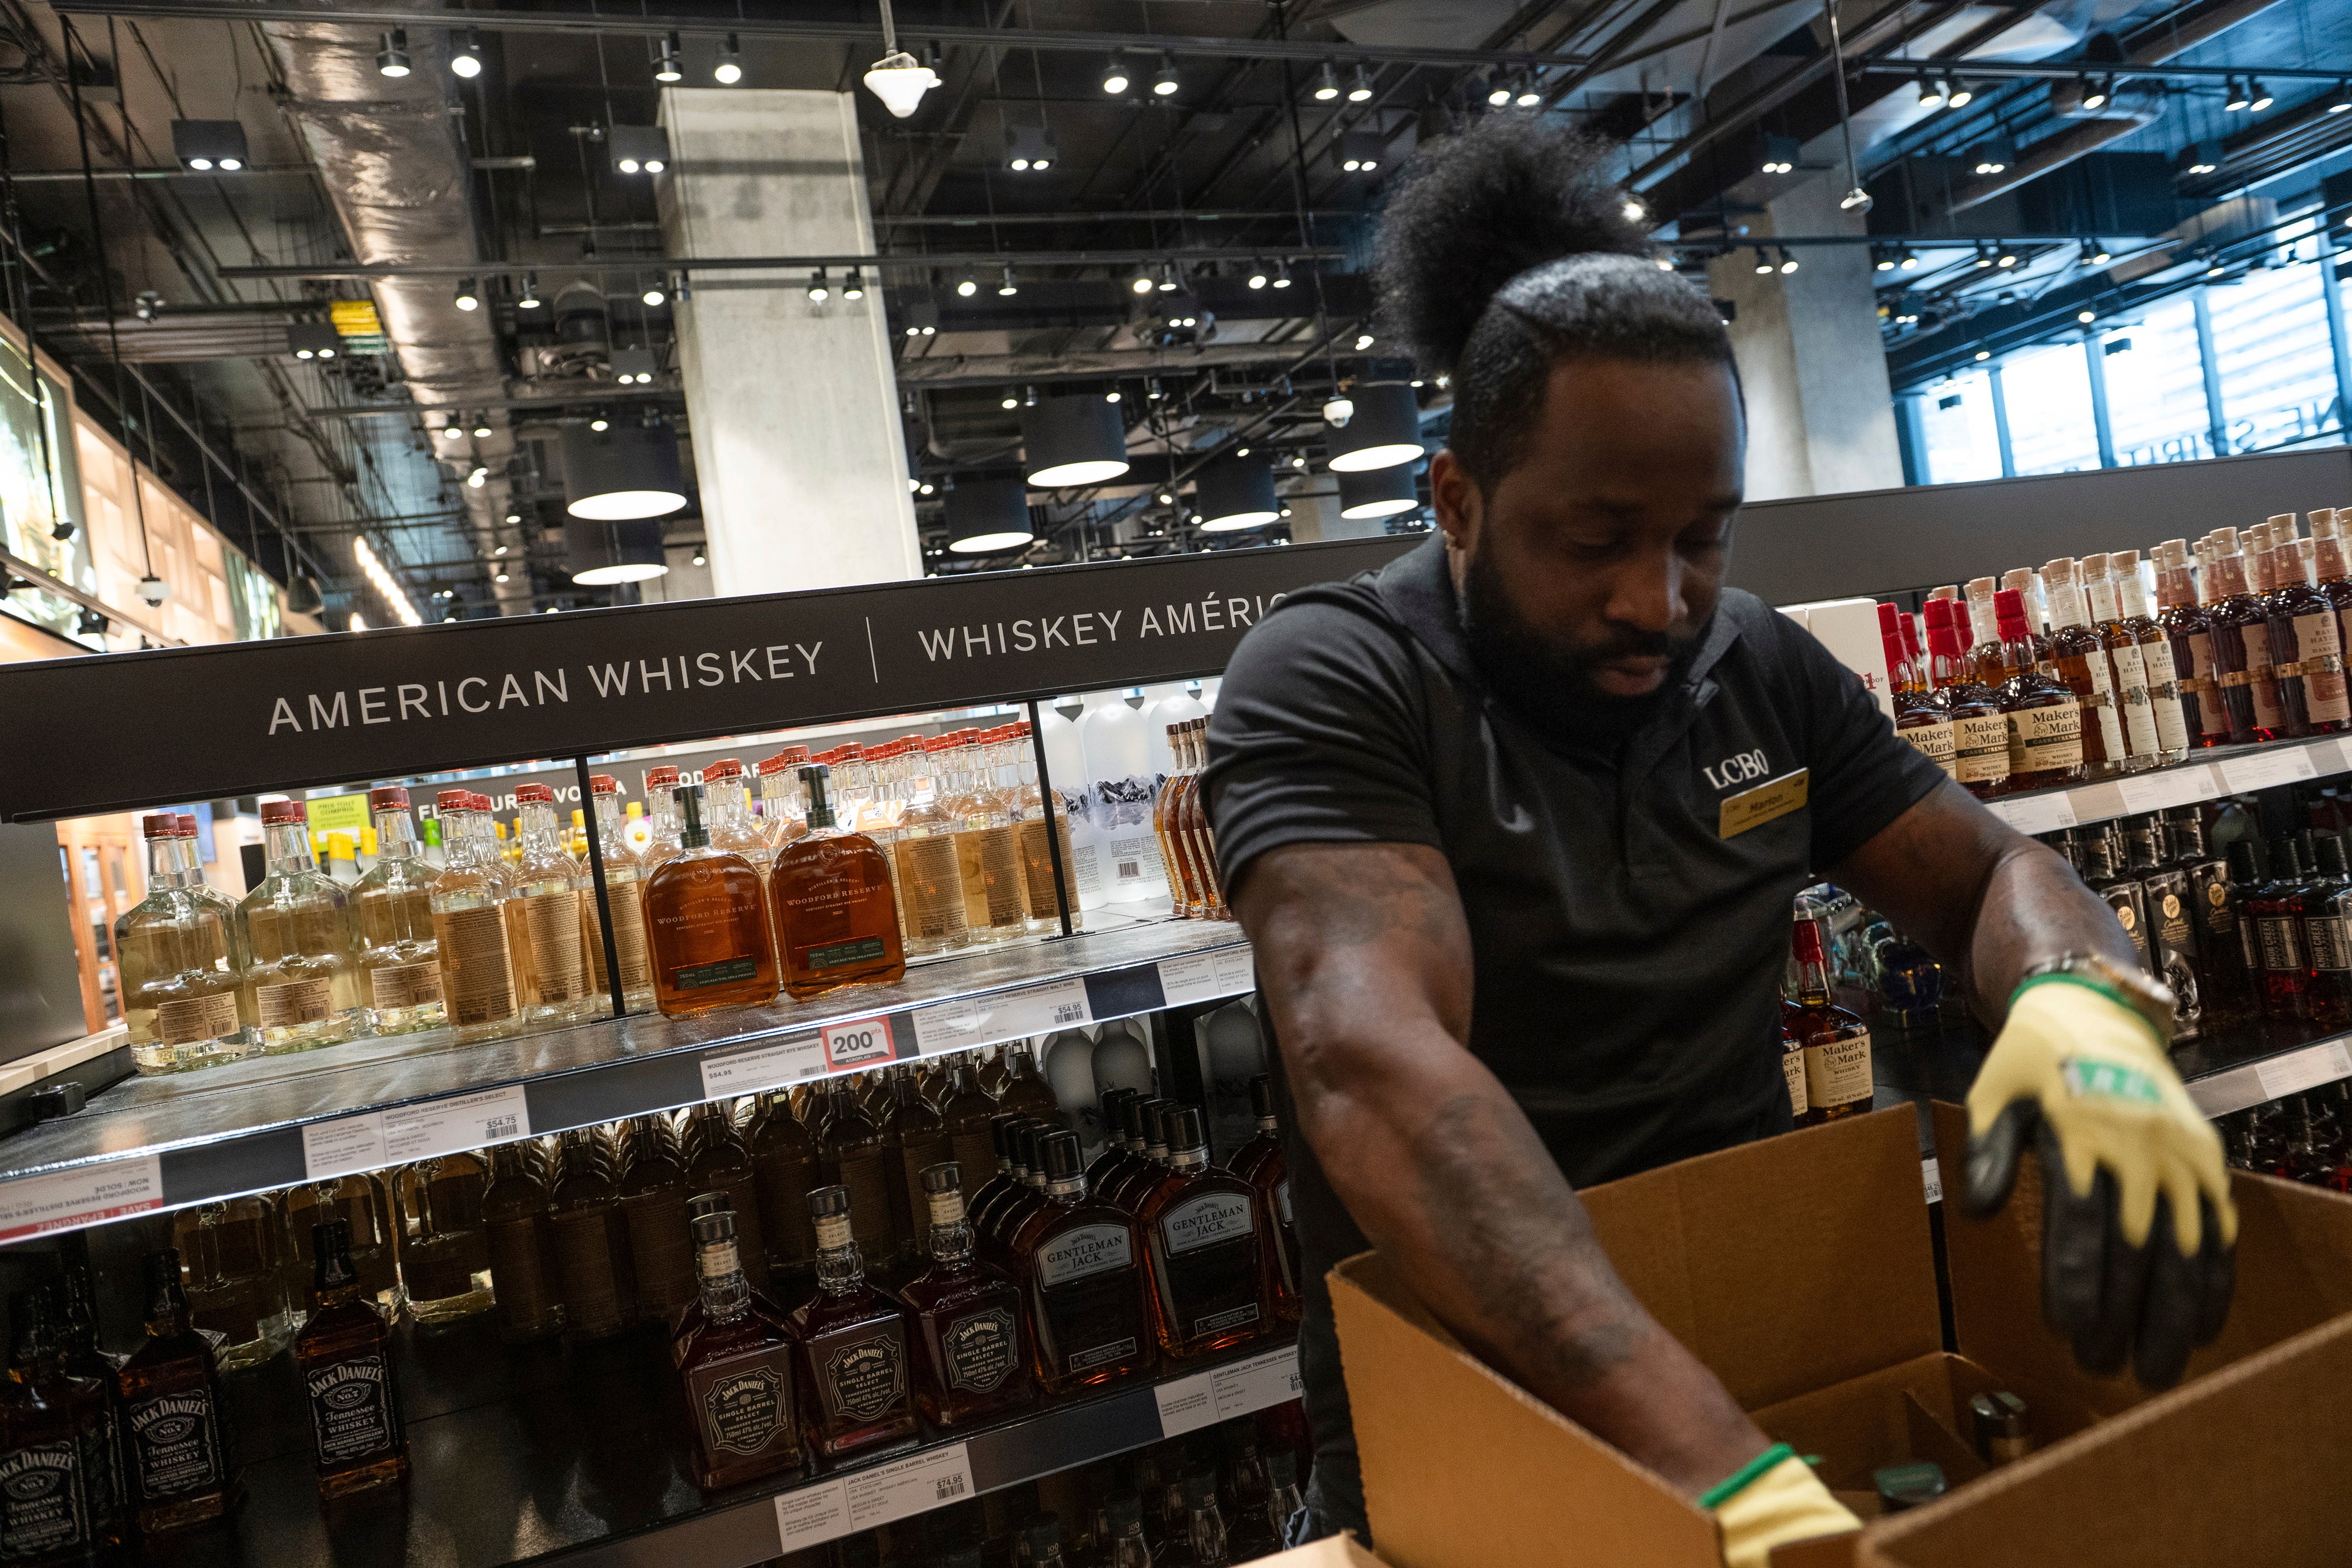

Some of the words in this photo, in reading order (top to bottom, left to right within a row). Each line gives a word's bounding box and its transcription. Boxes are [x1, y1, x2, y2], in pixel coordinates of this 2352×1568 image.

[917, 610, 1123, 661] WHISKEY
[268, 667, 569, 735] AMERICAN
[587, 641, 823, 698] WHISKEY
[2032, 707, 2080, 724] Maker's
[1906, 727, 1953, 743] Maker's
[1964, 719, 2008, 734] Maker's
[2049, 720, 2080, 735] Mark
[1979, 733, 2008, 745] Mark
[1922, 741, 1954, 755] Mark
[2052, 752, 2073, 760] WHISKY
[1702, 748, 1769, 790] LCBO
[808, 878, 838, 892] DISTILLER'S
[679, 898, 710, 910] DISTILLER'S
[786, 892, 838, 907] WOODFORD
[841, 885, 883, 897] RESERVE
[657, 912, 710, 925] WOODFORD
[713, 904, 756, 916] RESERVE
[2310, 920, 2323, 945] CREEK
[1214, 950, 1239, 958] WOODFORD
[2314, 945, 2326, 968] KNOB
[977, 995, 1005, 1004] WOODFORD
[1005, 991, 1027, 999] RESERVE
[1027, 987, 1050, 995] STRAIGHT
[1058, 1004, 1082, 1014] $54.95
[833, 1031, 873, 1055] 200
[870, 1027, 882, 1036] pts
[1823, 1040, 1866, 1057] Maker's
[704, 1047, 720, 1057] BONUS
[720, 1043, 745, 1054] AEROPLAN
[706, 1058, 738, 1069] WOODFORD
[737, 1054, 761, 1064] RESERVE
[761, 1049, 786, 1060] STRAIGHT
[796, 1042, 820, 1052] WHISKEY
[1838, 1051, 1866, 1065] Mark
[845, 1054, 871, 1064] AEROPLAN
[709, 1069, 732, 1079] $54.95
[1833, 1064, 1860, 1075] WHISKY
[385, 1109, 420, 1121] WOODFORD
[420, 1103, 449, 1114] RESERVE
[449, 1096, 483, 1109] DISTILLER'S
[484, 1091, 507, 1102] SELECT
[486, 1116, 517, 1129] $54.75
[95, 1182, 122, 1193] SOLDÉ
[128, 1177, 149, 1187] NOW
[65, 1195, 101, 1206] RESERVE
[103, 1185, 149, 1199] WOODFORD
[1172, 1204, 1244, 1231] GENTLEMAN
[1197, 1219, 1226, 1237] JACK
[1047, 1235, 1122, 1263] GENTLEMAN
[1071, 1251, 1102, 1269] JACK
[959, 1326, 975, 1341] JACK
[974, 1321, 999, 1332] DANIEL'S
[843, 1352, 860, 1368] JACK
[858, 1348, 884, 1359] DANIEL'S
[956, 1348, 980, 1360] SINGLE
[982, 1340, 1007, 1352] BARREL
[972, 1352, 994, 1362] SELECT
[961, 1360, 986, 1371] TENNESSEE
[987, 1355, 1005, 1363] WHISKEY
[963, 1369, 977, 1379] 750ml
[987, 1360, 1006, 1370] alc./vol.
[1212, 1368, 1240, 1379] GENTLEMAN
[1240, 1363, 1252, 1372] JACK
[1252, 1356, 1277, 1368] TENNESSEE
[1278, 1350, 1297, 1360] WHISKEY
[308, 1372, 339, 1398] JACK
[337, 1365, 385, 1382] DANIEL'S
[839, 1375, 864, 1388] SINGLE
[867, 1368, 893, 1379] BARREL
[856, 1378, 879, 1389] SELECT
[974, 1370, 998, 1380] LYNCHBURG
[721, 1385, 740, 1401] JACK
[738, 1380, 766, 1390] DANIEL'S
[845, 1388, 871, 1399] TENNESSEE
[871, 1382, 891, 1390] WHISKEY
[846, 1396, 861, 1406] 750ml
[872, 1388, 891, 1398] alc./vol.
[719, 1407, 744, 1420] SINGLE
[747, 1399, 776, 1412] BARREL
[858, 1398, 883, 1408] LYNCHBURG
[131, 1407, 161, 1432] JACK
[159, 1398, 209, 1416] DANIEL'S
[325, 1405, 375, 1423] Tennessee
[724, 1420, 751, 1431] TENNESSEE
[752, 1414, 773, 1423] WHISKEY
[735, 1410, 760, 1422] SELECT
[328, 1416, 376, 1434] WHISKEY
[726, 1430, 741, 1439] 750ml
[753, 1420, 774, 1431] alc./vol.
[737, 1430, 764, 1441] LYNCHBURG
[147, 1439, 199, 1456] Tennessee
[21, 1450, 76, 1470] DANIEL'S
[149, 1450, 200, 1469] WHISKEY
[847, 1476, 861, 1486] JACK
[862, 1470, 886, 1482] DANIEL'S
[886, 1465, 904, 1475] SINGLE
[905, 1458, 926, 1469] BARREL
[926, 1451, 949, 1463] WHISKEY
[936, 1474, 963, 1489] $74.95
[1204, 1493, 1214, 1503] 100
[1128, 1521, 1140, 1531] 100
[1047, 1543, 1059, 1553] 100
